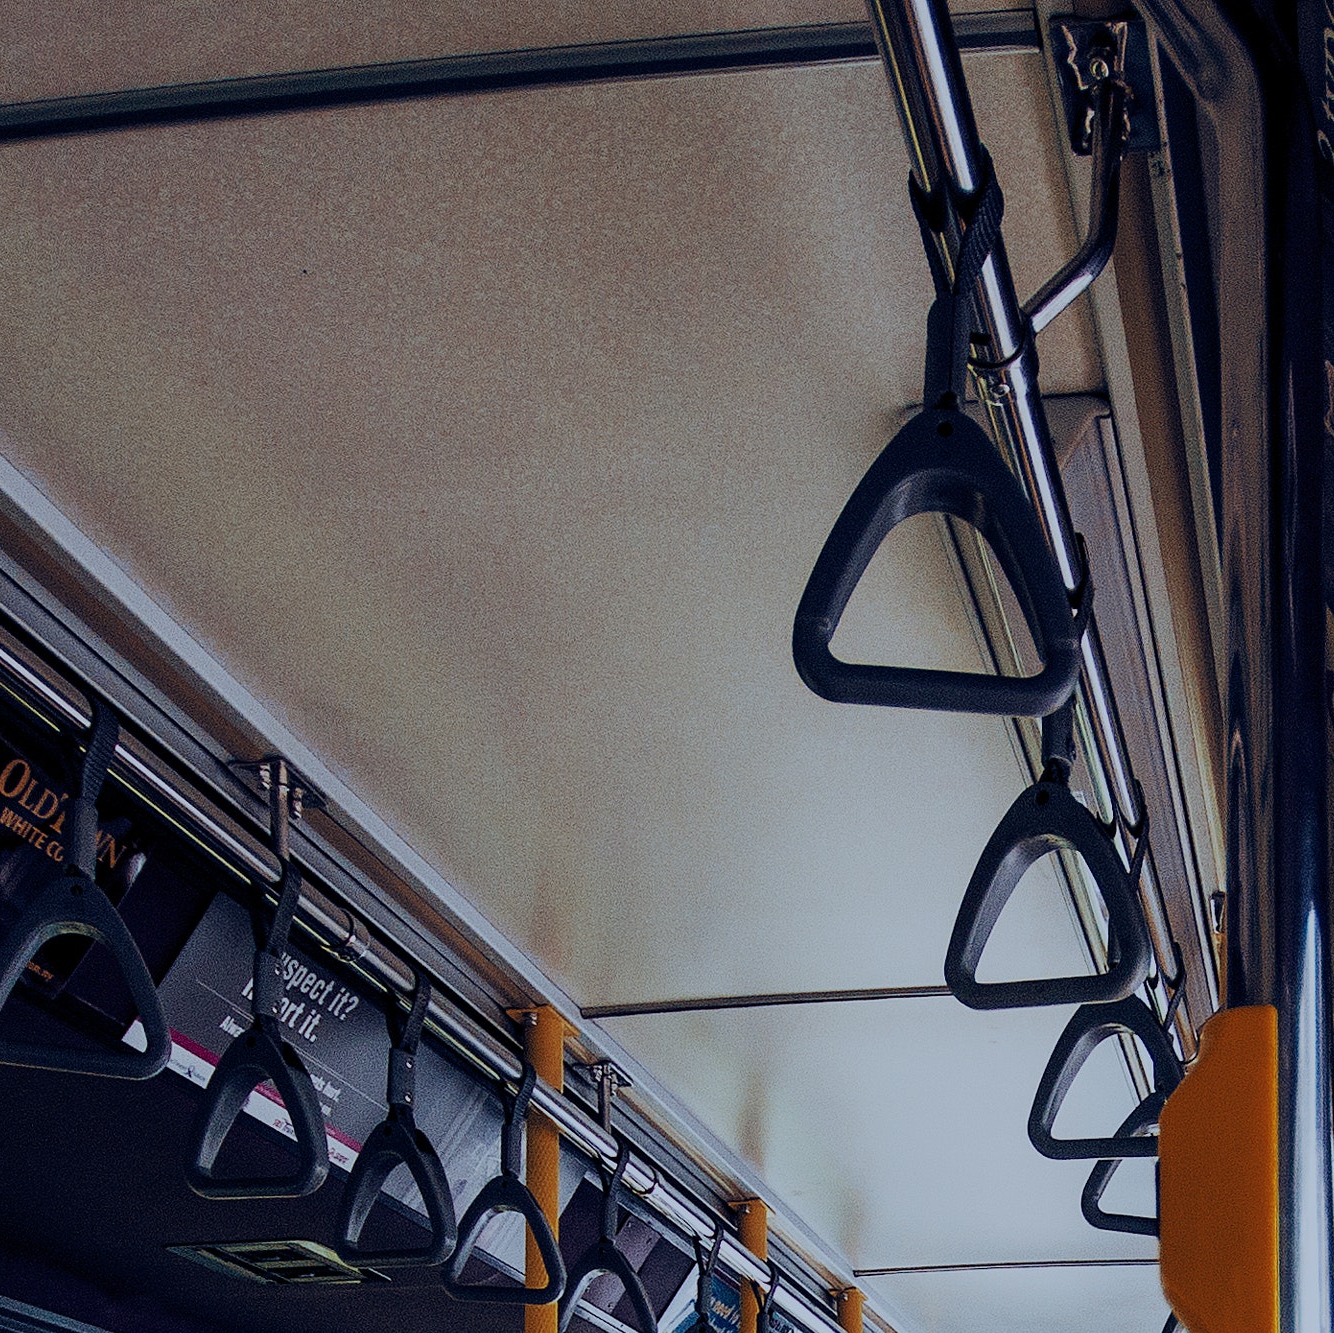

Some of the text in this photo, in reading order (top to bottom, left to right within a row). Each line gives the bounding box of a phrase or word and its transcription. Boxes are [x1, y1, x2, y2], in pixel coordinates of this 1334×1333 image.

[0, 806, 49, 851] WHITE
[280, 951, 360, 1021] spect it?
[297, 1008, 322, 1042] it.
